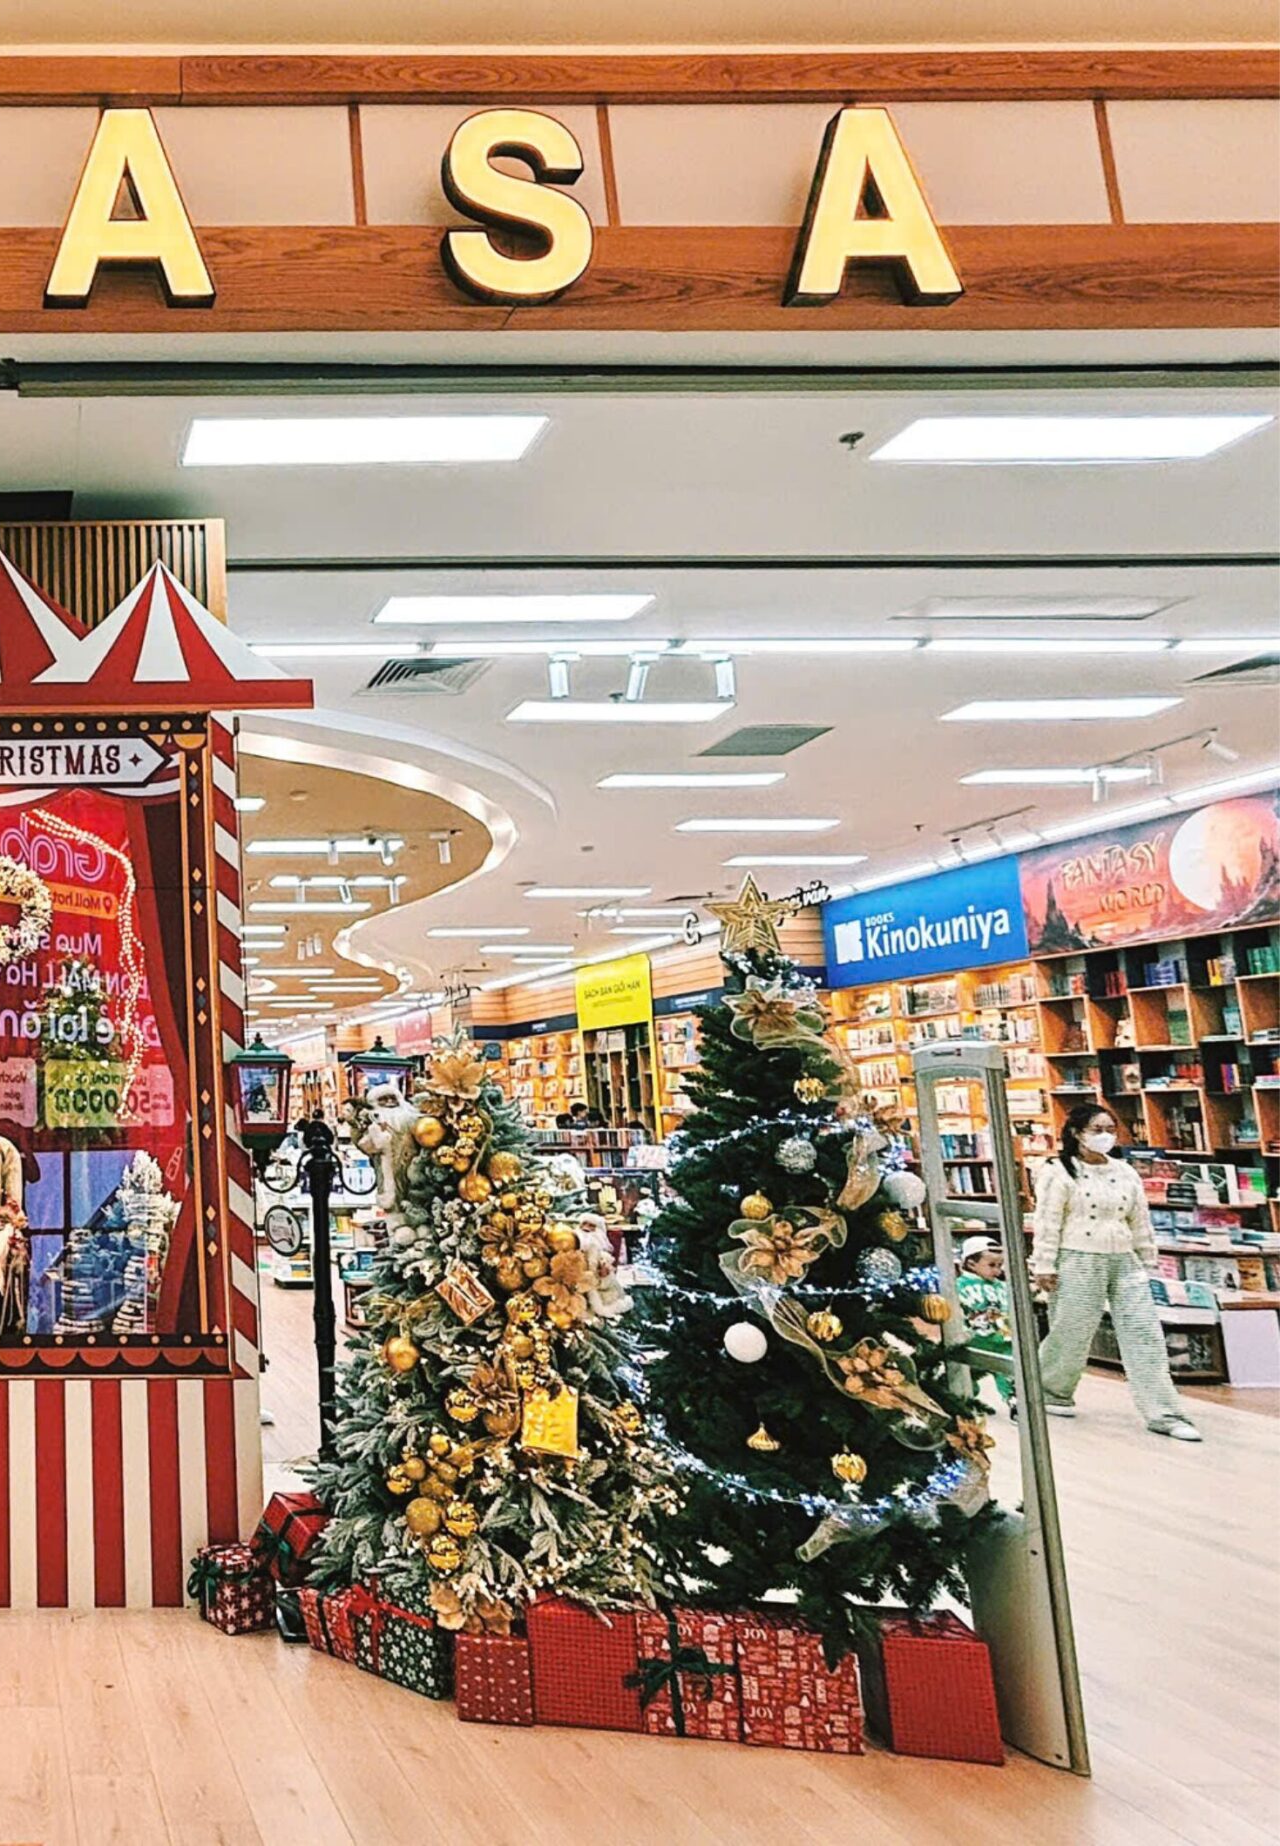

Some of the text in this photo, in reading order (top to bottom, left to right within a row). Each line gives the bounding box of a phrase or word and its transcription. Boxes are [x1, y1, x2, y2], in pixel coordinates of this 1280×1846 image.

[1062, 832, 1166, 889] FANTASY
[1100, 883, 1166, 912] WORLD
[865, 912, 895, 927] BOOKS
[867, 905, 1010, 960] Kinokuniya
[743, 1627, 768, 1642] JOY
[749, 1705, 774, 1720] JOY
